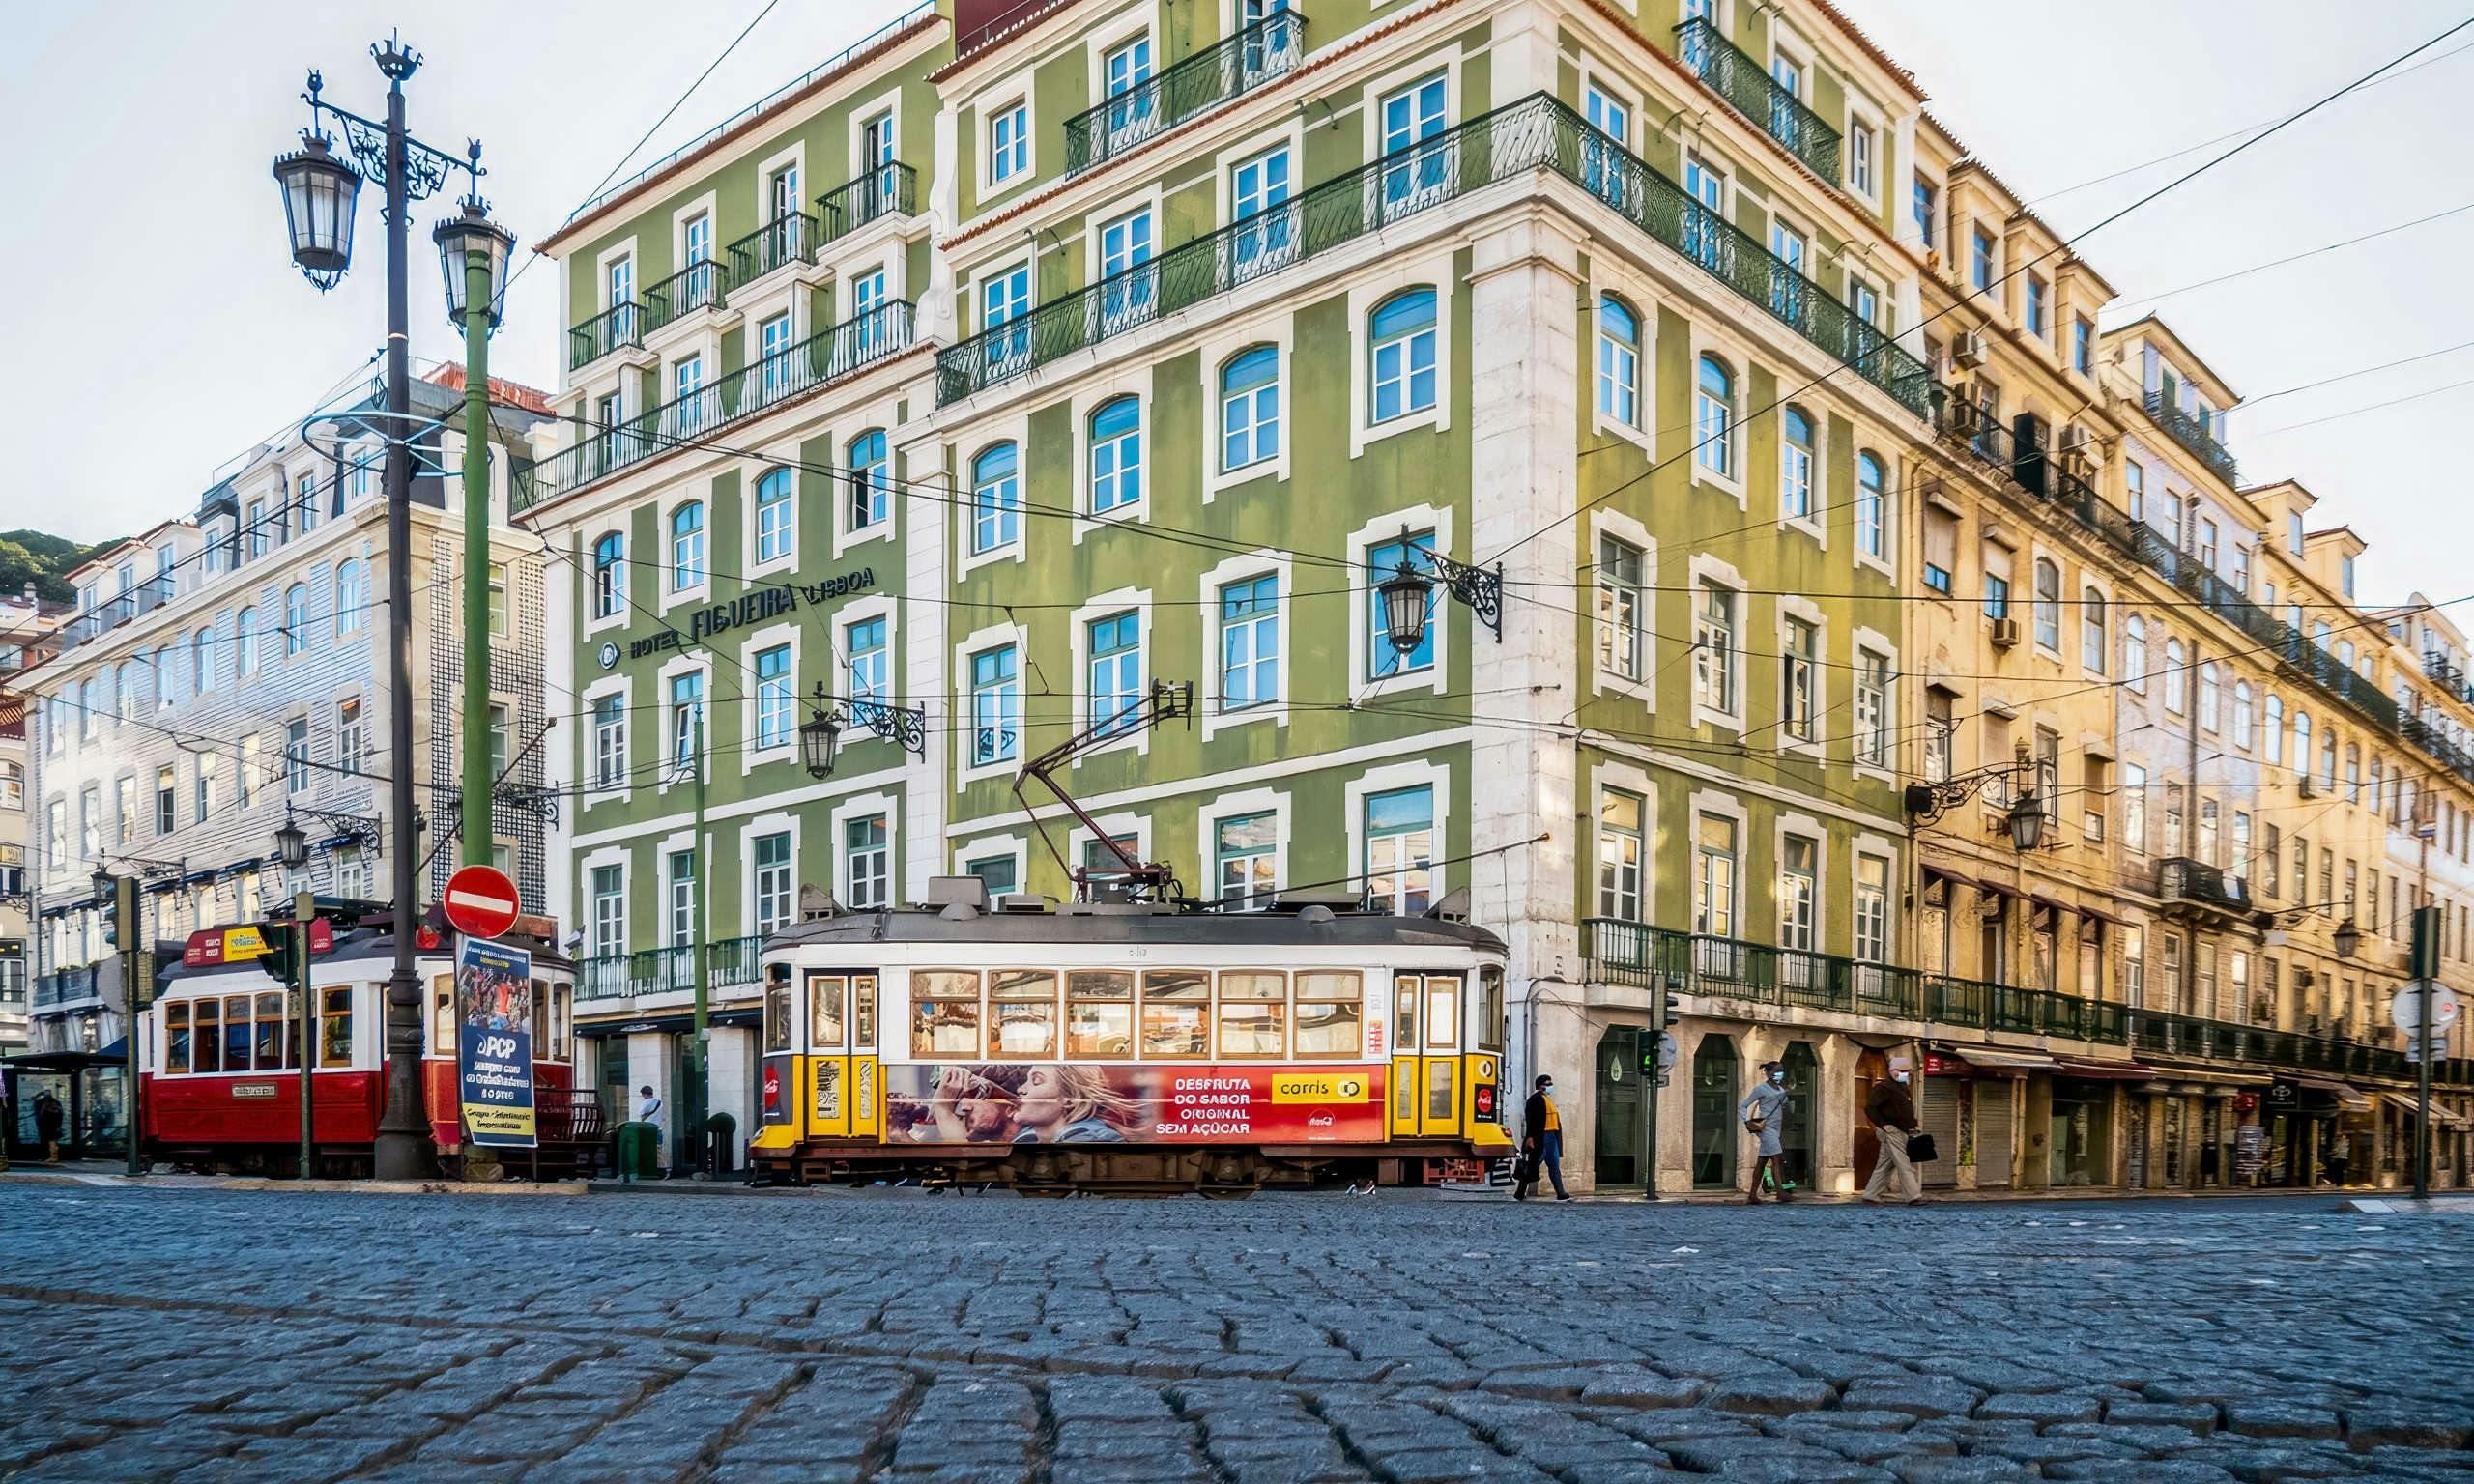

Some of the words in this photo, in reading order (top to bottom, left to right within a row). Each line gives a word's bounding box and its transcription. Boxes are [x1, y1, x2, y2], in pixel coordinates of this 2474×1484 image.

[630, 630, 680, 659] HOTEL
[690, 583, 797, 642] FIGUEIRA
[805, 567, 876, 605] LISBOA
[486, 1036, 517, 1059] PCP
[1175, 1078, 1251, 1091] DESFRUTA
[1280, 1079, 1329, 1095] carris
[1174, 1094, 1196, 1105] DO
[1199, 1094, 1251, 1105] SABOR
[1155, 1123, 1188, 1134] SEM
[1190, 1121, 1250, 1136] AÇÚCAR
